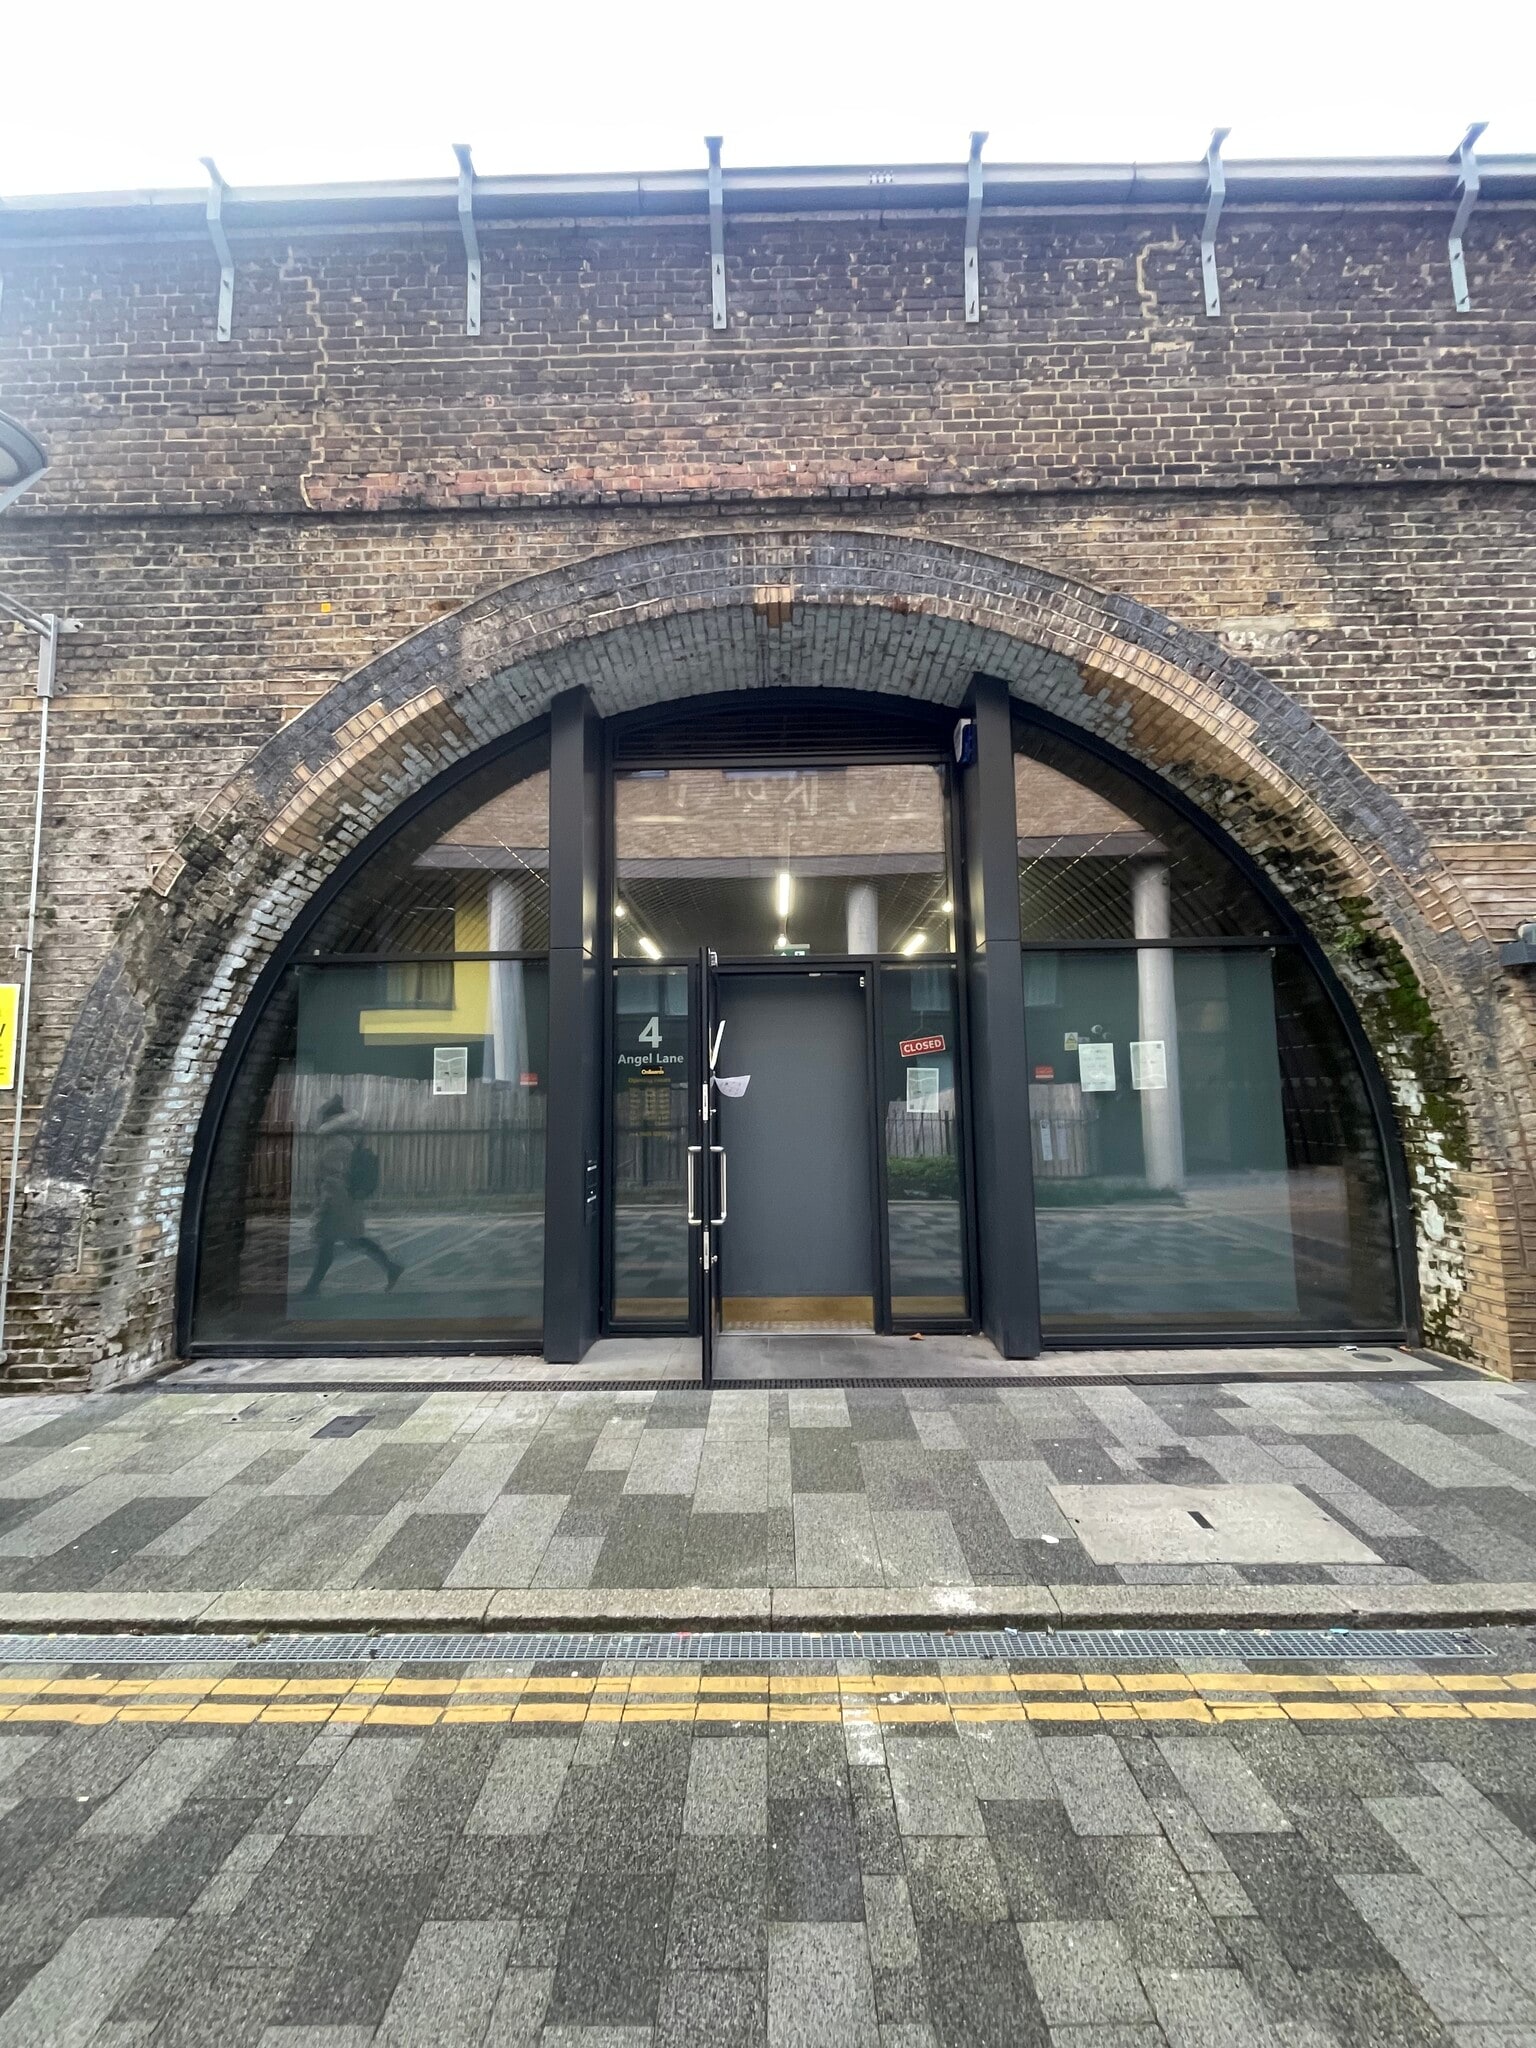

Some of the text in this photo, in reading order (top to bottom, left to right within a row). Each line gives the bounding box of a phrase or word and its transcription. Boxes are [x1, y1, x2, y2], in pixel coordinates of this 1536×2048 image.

[638, 1016, 663, 1048] 4
[903, 1039, 942, 1053] CLOSED
[617, 1052, 684, 1067] Angel Lane
